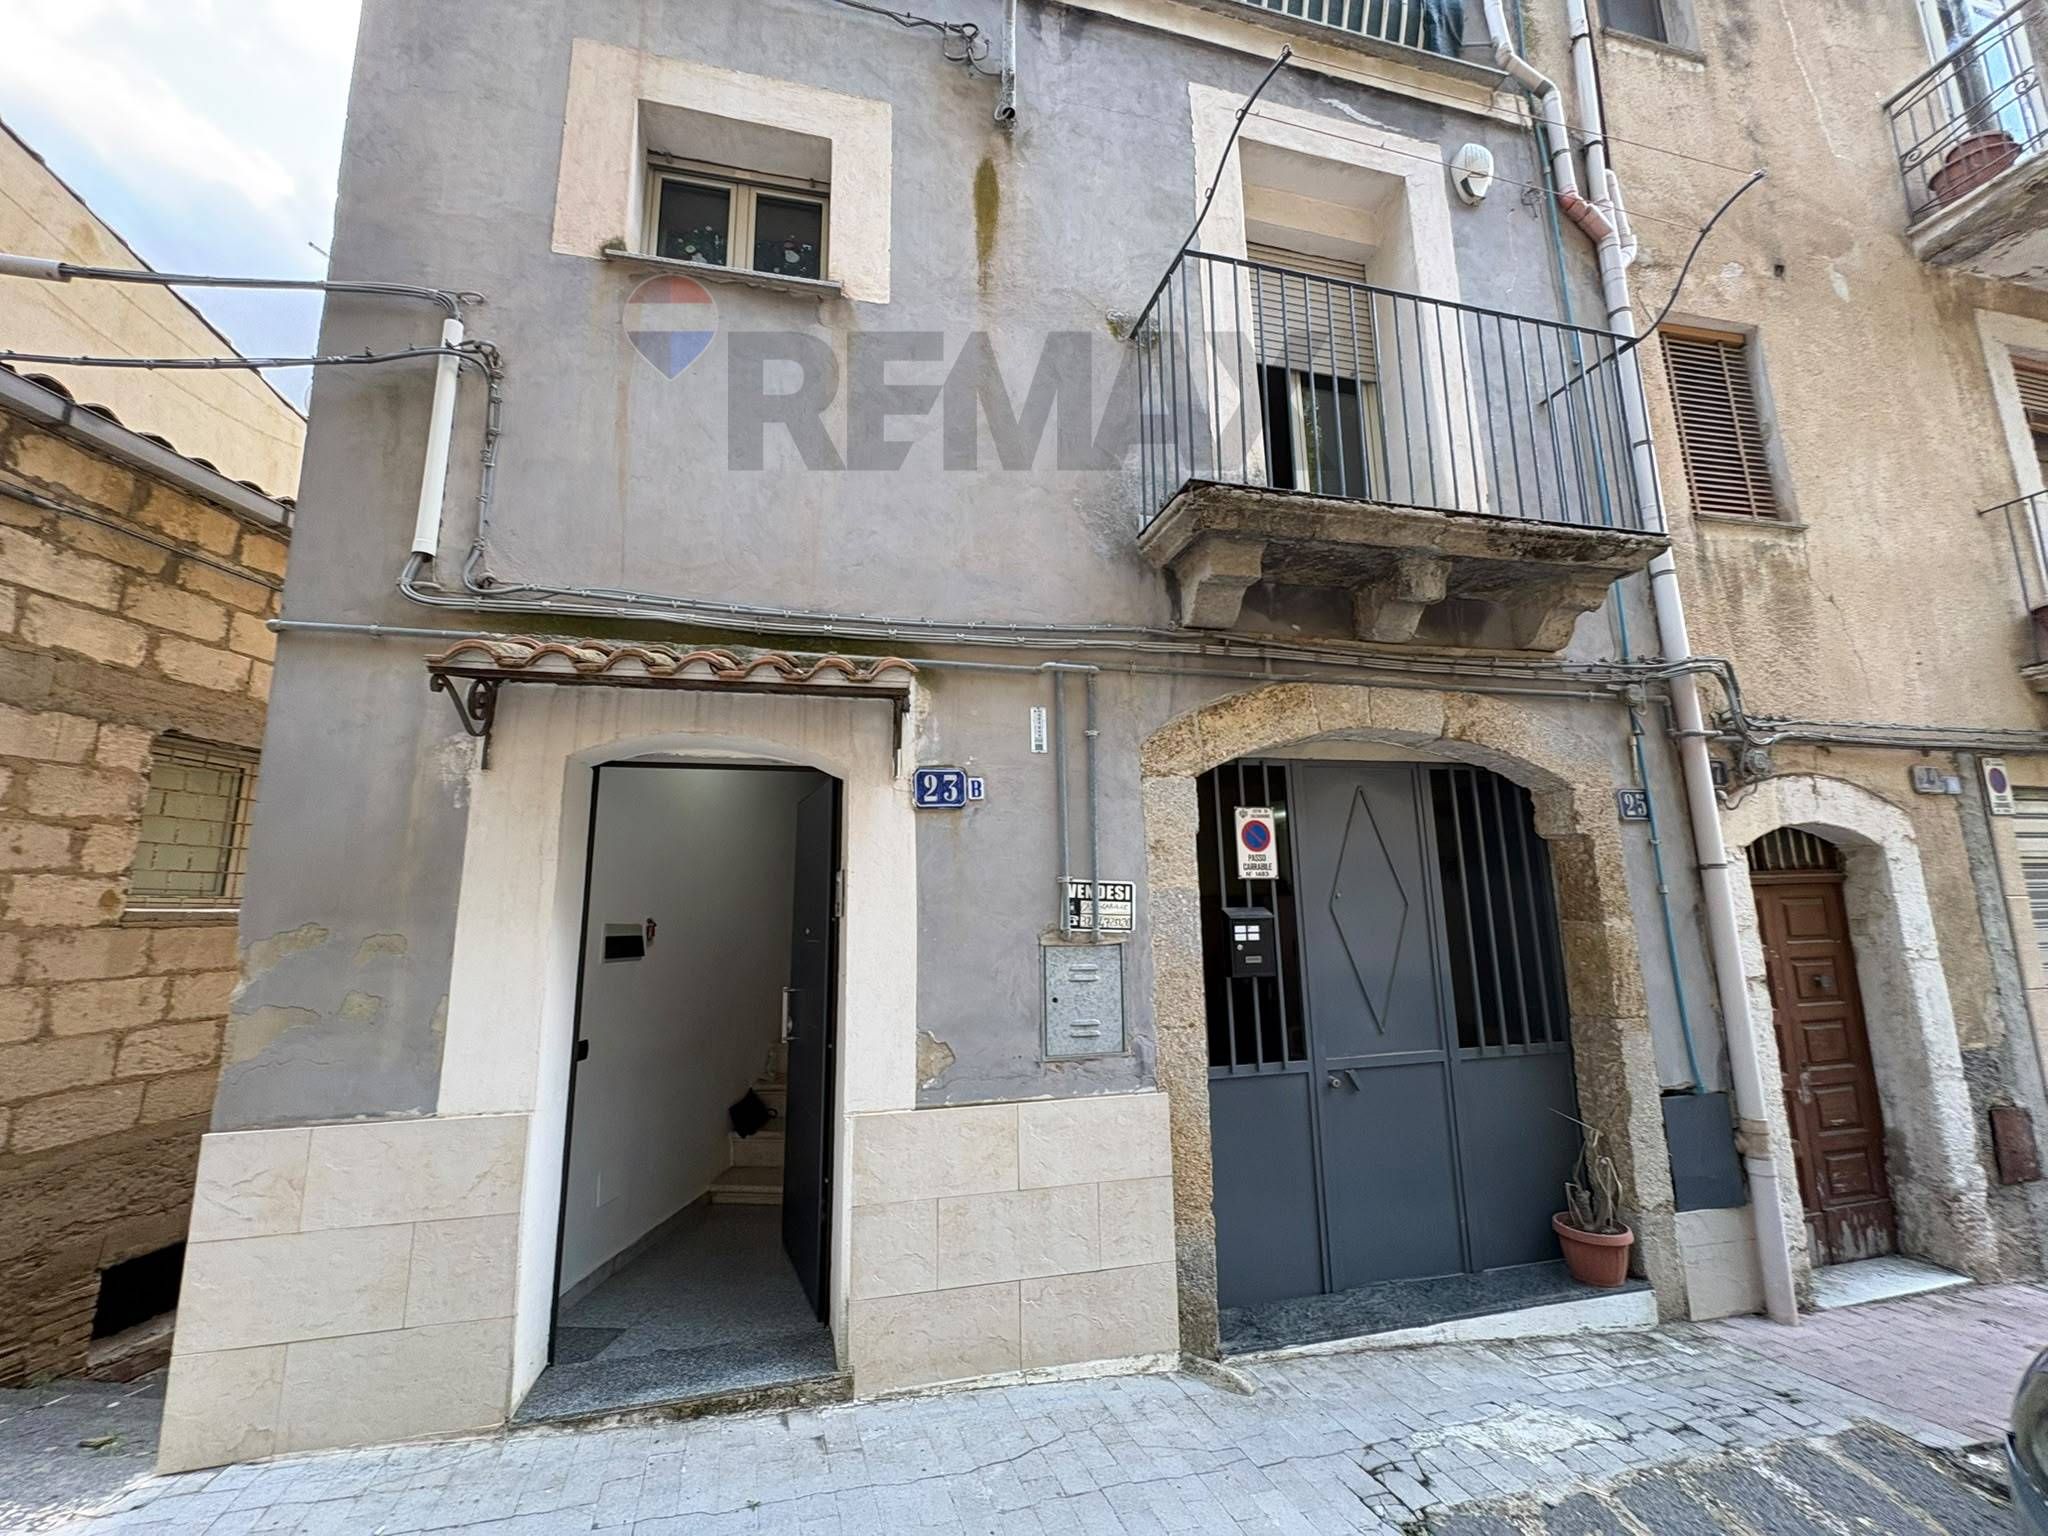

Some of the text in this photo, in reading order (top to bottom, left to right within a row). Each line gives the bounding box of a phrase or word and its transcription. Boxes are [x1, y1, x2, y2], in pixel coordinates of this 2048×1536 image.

[923, 774, 982, 802] 23 B
[1624, 793, 1647, 816] 25
[1247, 854, 1267, 862] PASSO
[1243, 863, 1272, 871] CARRABILE
[1067, 883, 1131, 900] VENDESI
